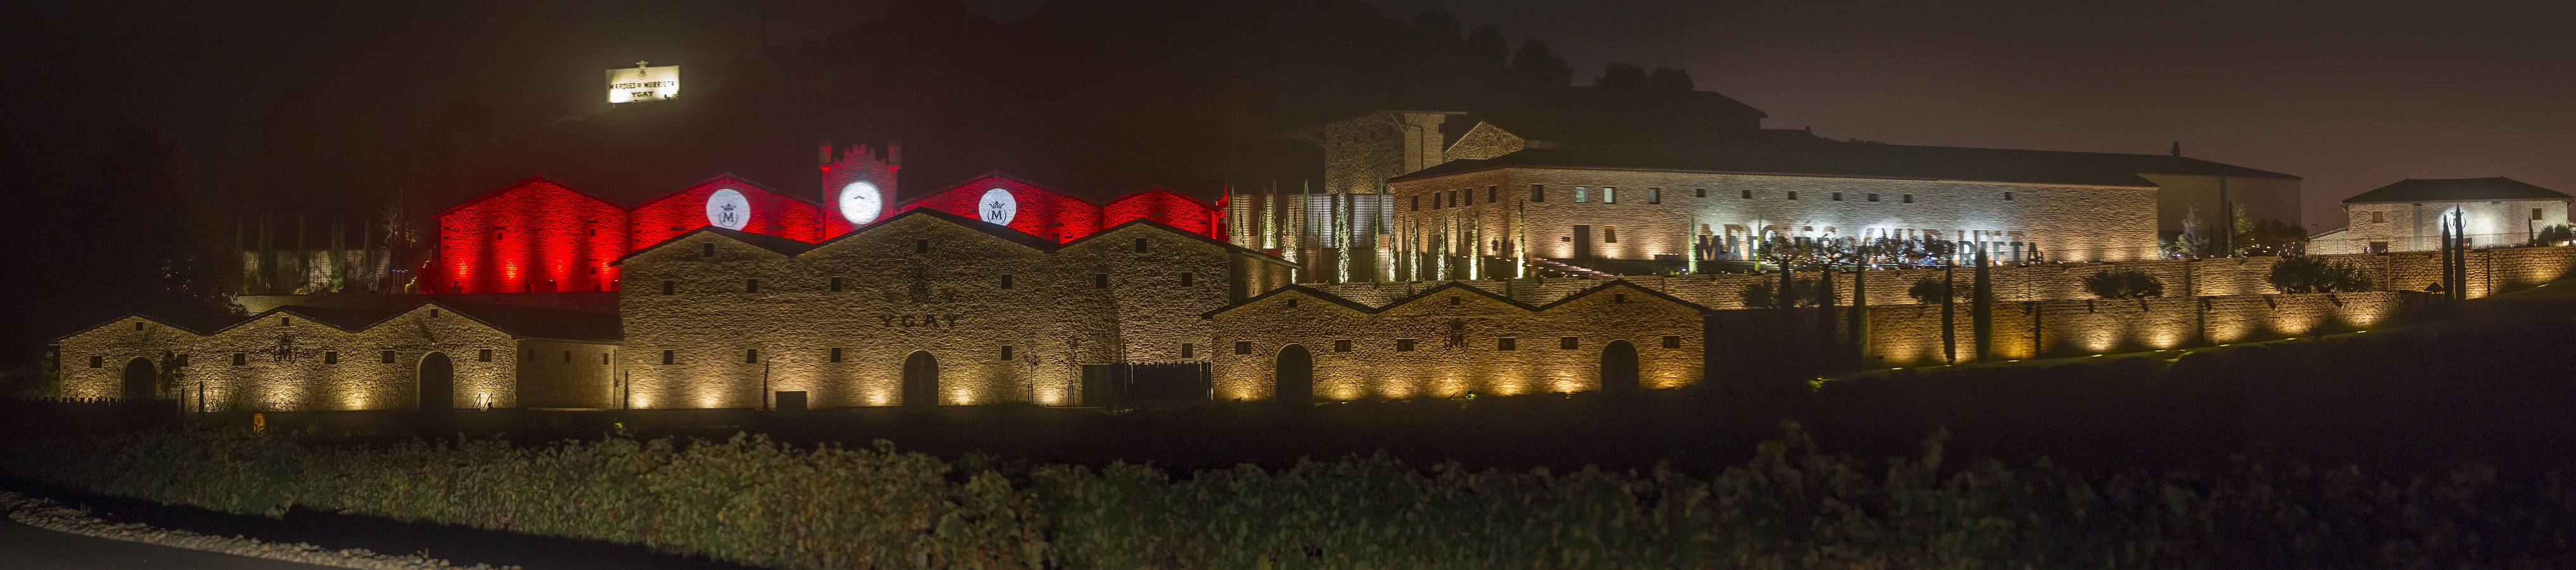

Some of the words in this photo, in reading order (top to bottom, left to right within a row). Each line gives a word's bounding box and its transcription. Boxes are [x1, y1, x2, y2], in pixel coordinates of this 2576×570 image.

[722, 212, 734, 222] M
[990, 210, 1003, 220] M
[879, 314, 964, 329] YGAY
